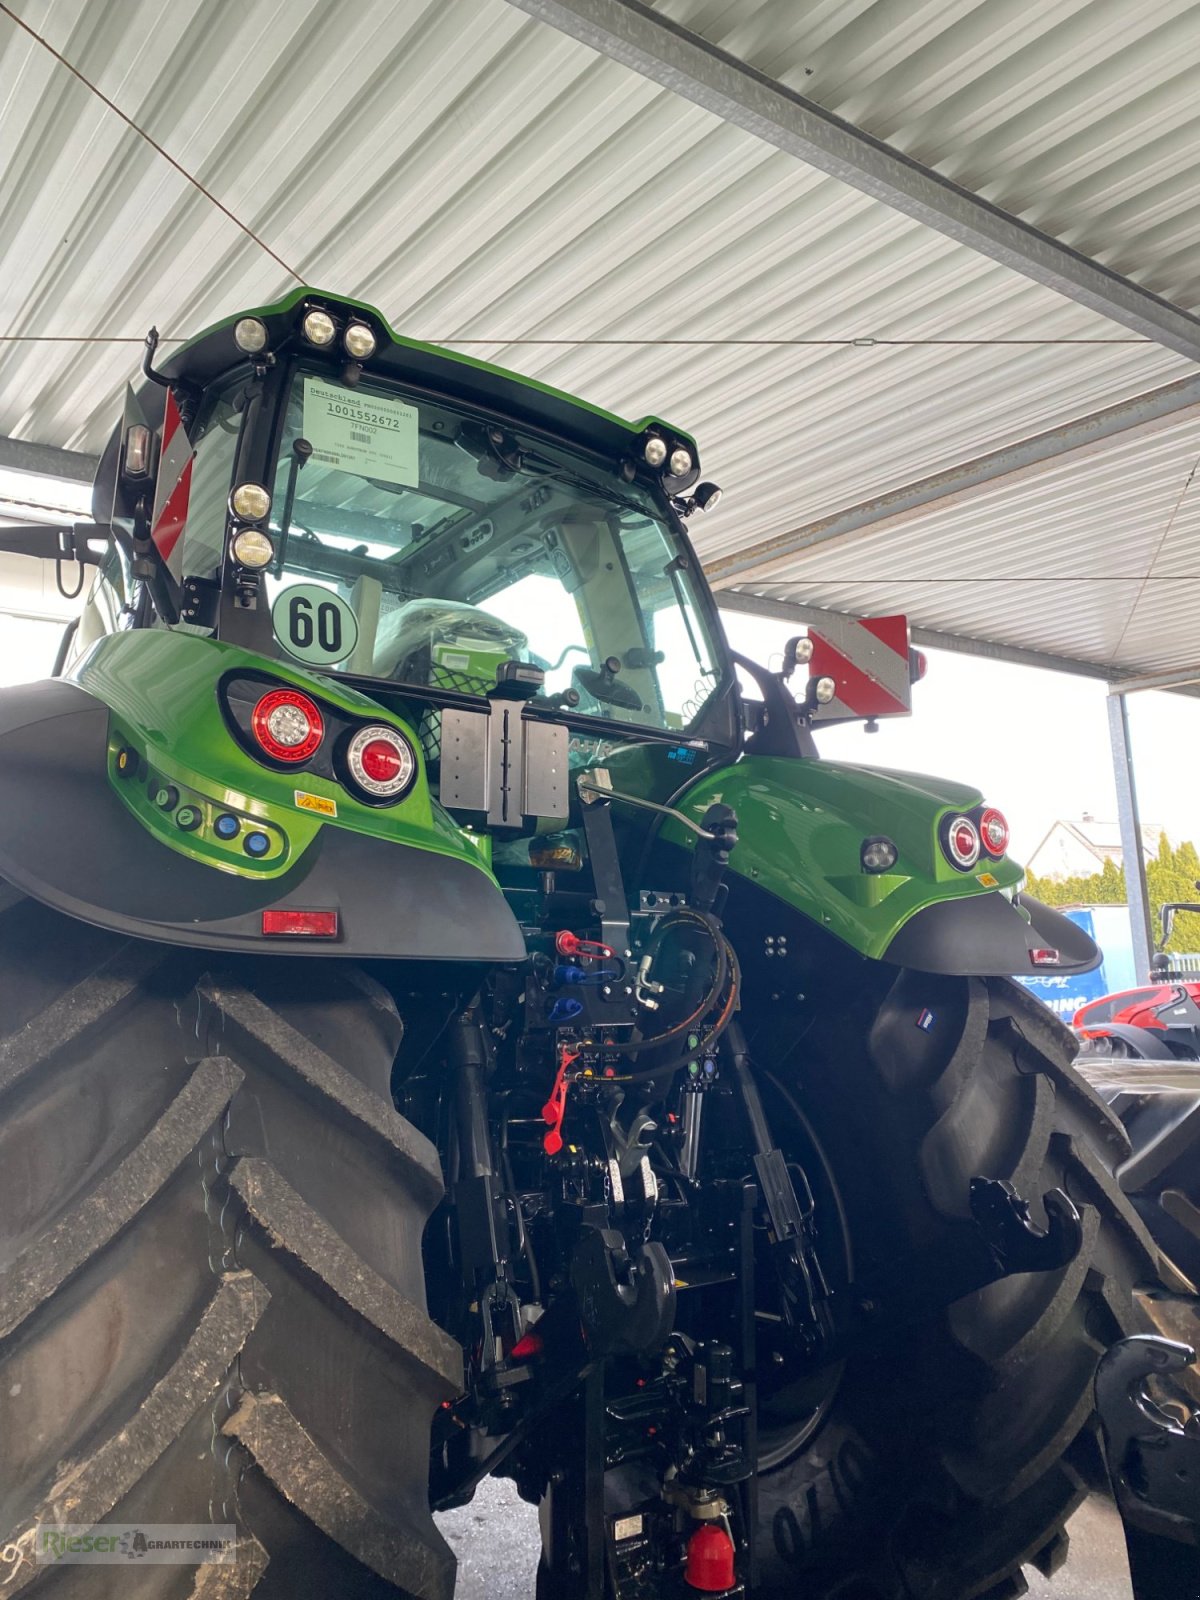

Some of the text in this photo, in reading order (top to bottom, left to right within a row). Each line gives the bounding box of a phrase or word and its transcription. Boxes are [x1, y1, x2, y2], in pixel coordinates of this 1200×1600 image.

[310, 387, 361, 406] Deutschland
[327, 402, 400, 429] 1001552672
[351, 423, 377, 435] 7FN002
[289, 596, 342, 653] 60
